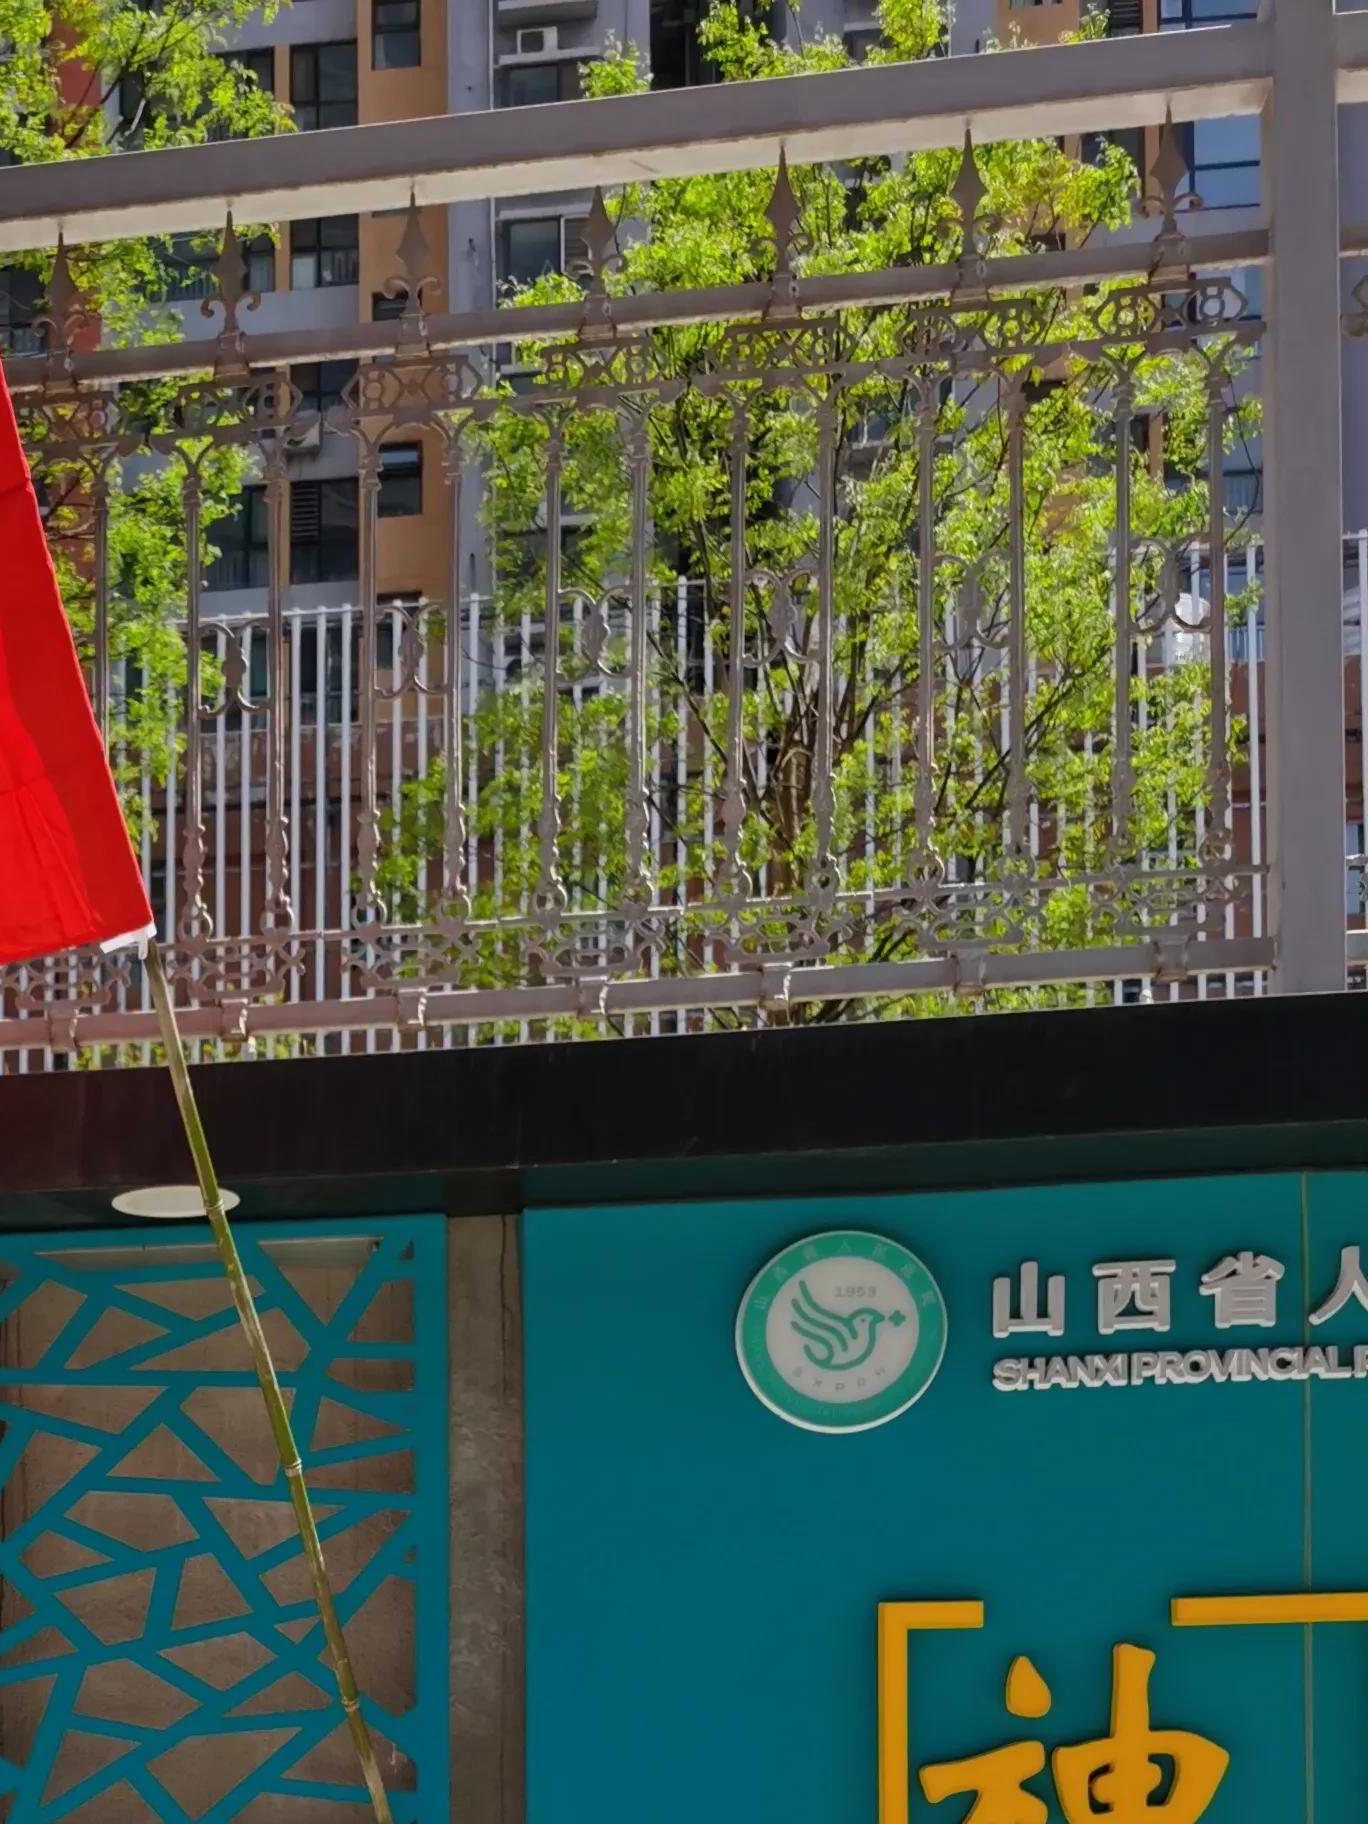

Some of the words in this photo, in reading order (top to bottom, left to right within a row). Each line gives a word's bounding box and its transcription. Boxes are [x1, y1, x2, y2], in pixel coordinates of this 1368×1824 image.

[993, 1246, 1368, 1338] 山西省人
[993, 1353, 1128, 1391] SHANXI
[1131, 1346, 1352, 1386] PROVINCIAL
